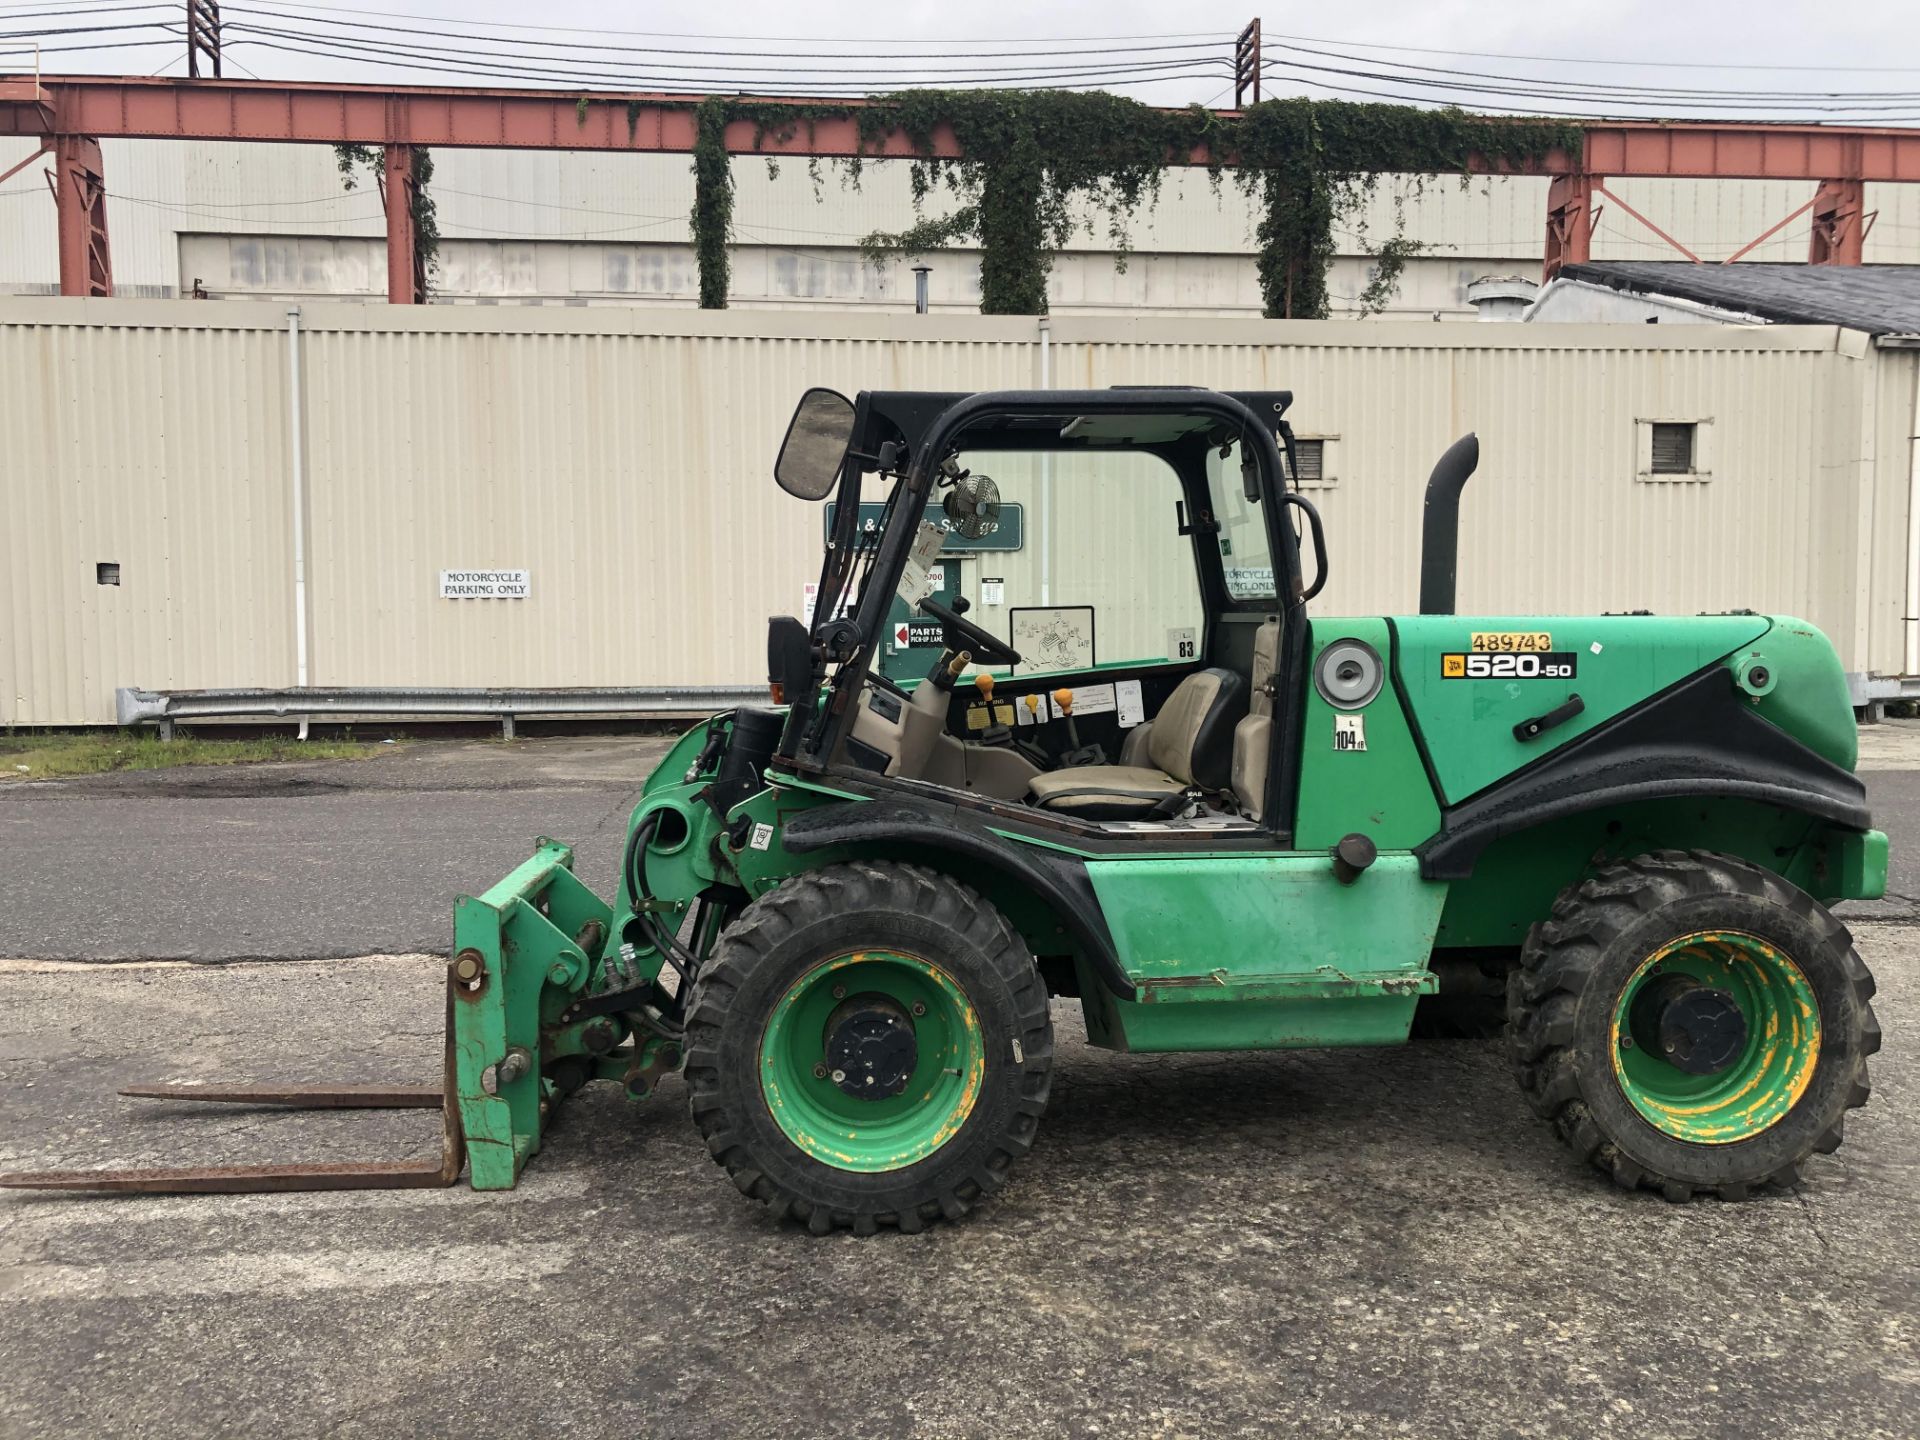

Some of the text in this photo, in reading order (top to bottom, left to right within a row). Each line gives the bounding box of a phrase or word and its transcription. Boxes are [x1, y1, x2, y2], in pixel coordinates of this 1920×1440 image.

[447, 573, 522, 582] MOTORCYCLE
[444, 585, 526, 594] PARKING ONLY
[910, 628, 943, 636] PARTS
[1179, 641, 1194, 657] 83
[1473, 634, 1551, 652] 489743
[1466, 654, 1572, 677] 520-50
[1335, 730, 1356, 750] 104
